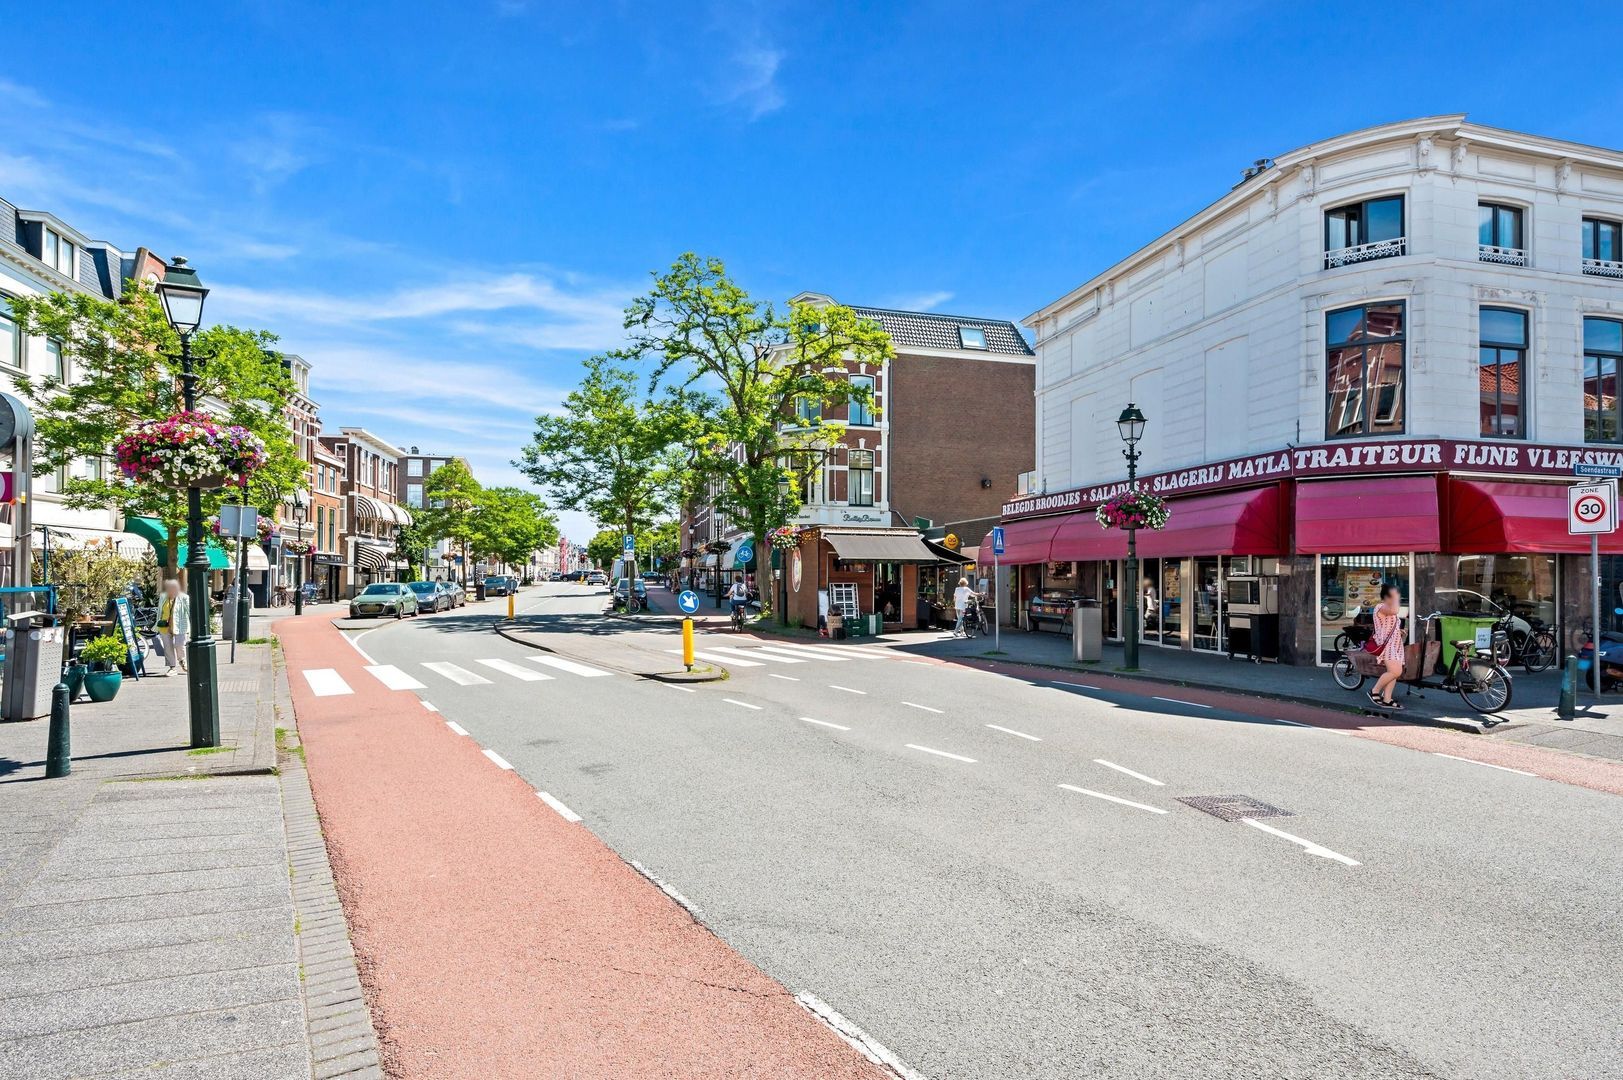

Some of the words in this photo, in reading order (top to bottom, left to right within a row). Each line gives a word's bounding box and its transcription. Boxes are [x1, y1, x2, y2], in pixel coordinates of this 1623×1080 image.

[1294, 443, 1442, 469] TRAITEUR
[1453, 444, 1519, 467] FIJNE
[1580, 465, 1618, 475] Soendastraat
[1002, 500, 1035, 516] BELEGDE
[1035, 491, 1081, 510] BROODJES
[1152, 465, 1224, 492] SLAGERIJ
[1227, 453, 1291, 480] MATLA
[1580, 503, 1601, 515] 30
[626, 536, 633, 544] P
